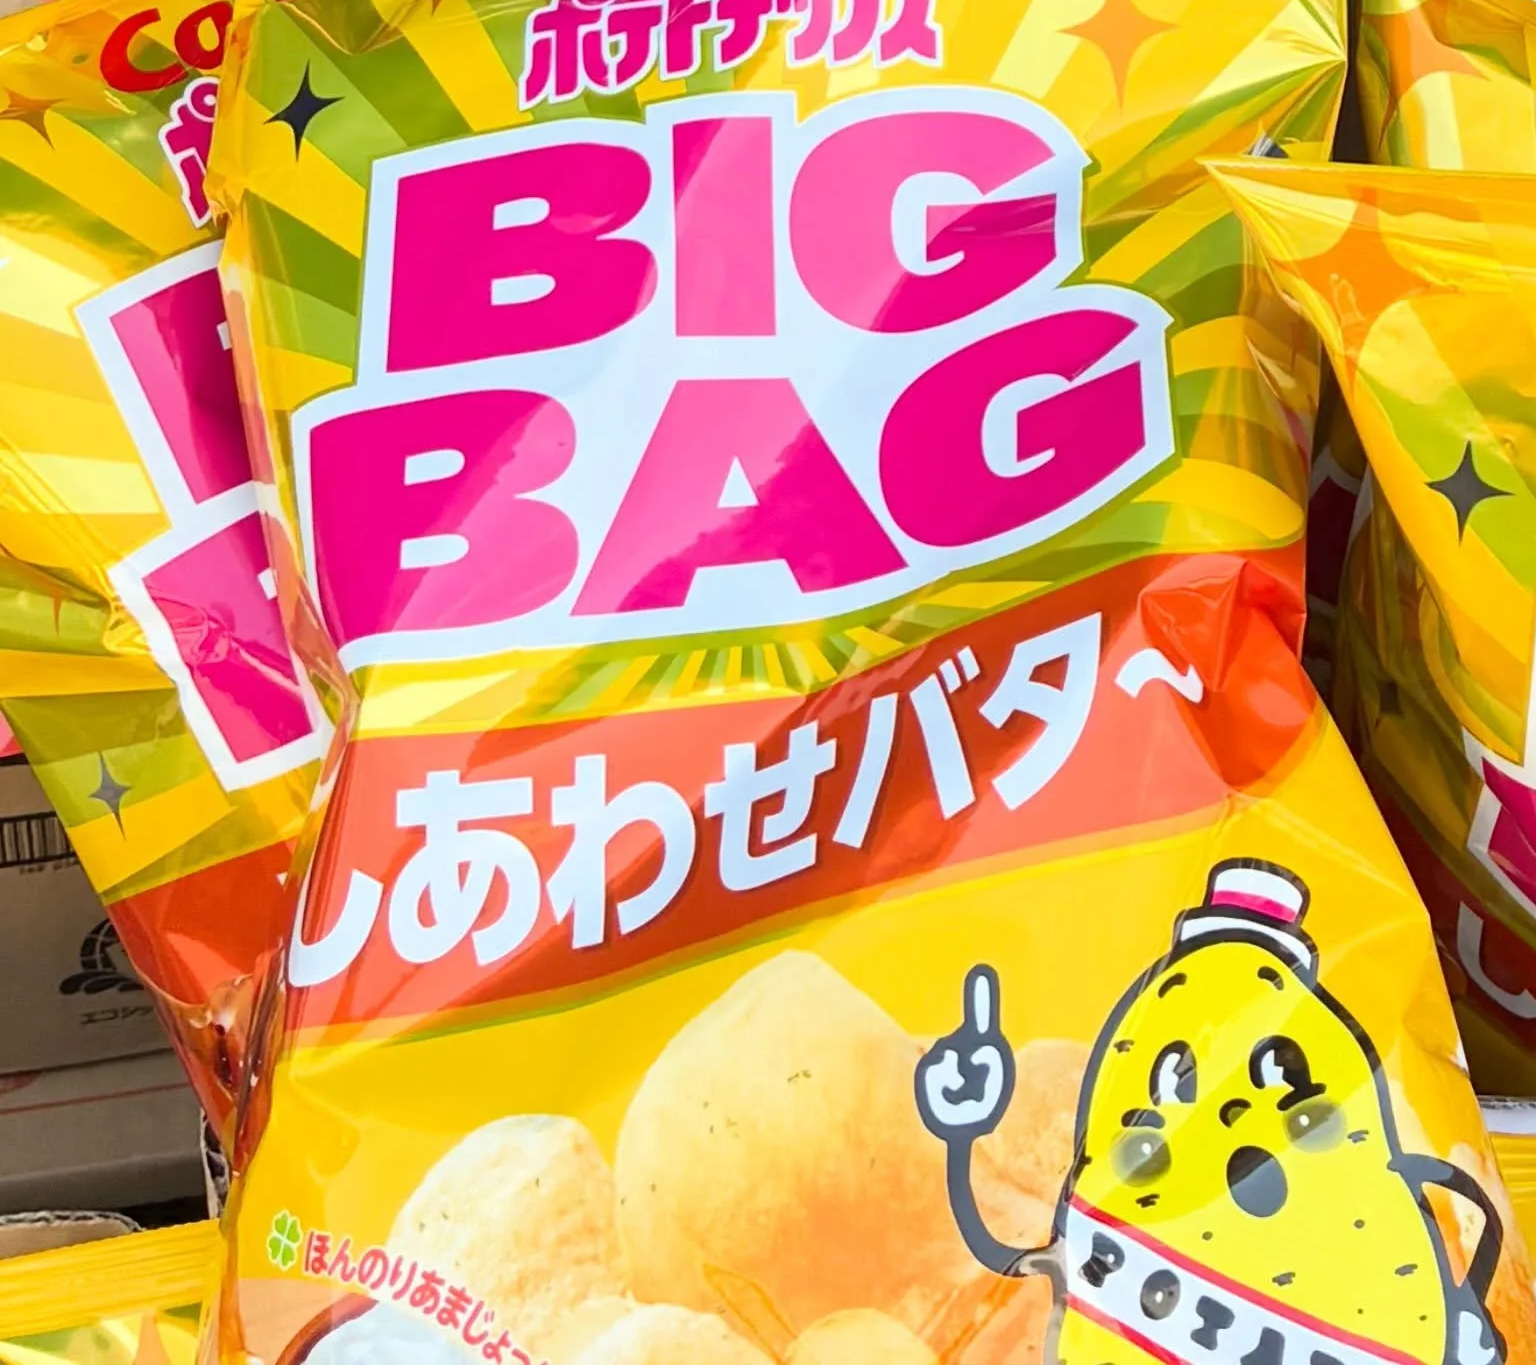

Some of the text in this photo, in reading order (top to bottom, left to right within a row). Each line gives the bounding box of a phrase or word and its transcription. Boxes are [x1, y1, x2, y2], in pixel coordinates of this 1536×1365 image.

[385, 109, 1058, 373] BIG
[308, 308, 1147, 645] BAG
[304, 1229, 550, 1365] ほんのりあまじょっ
